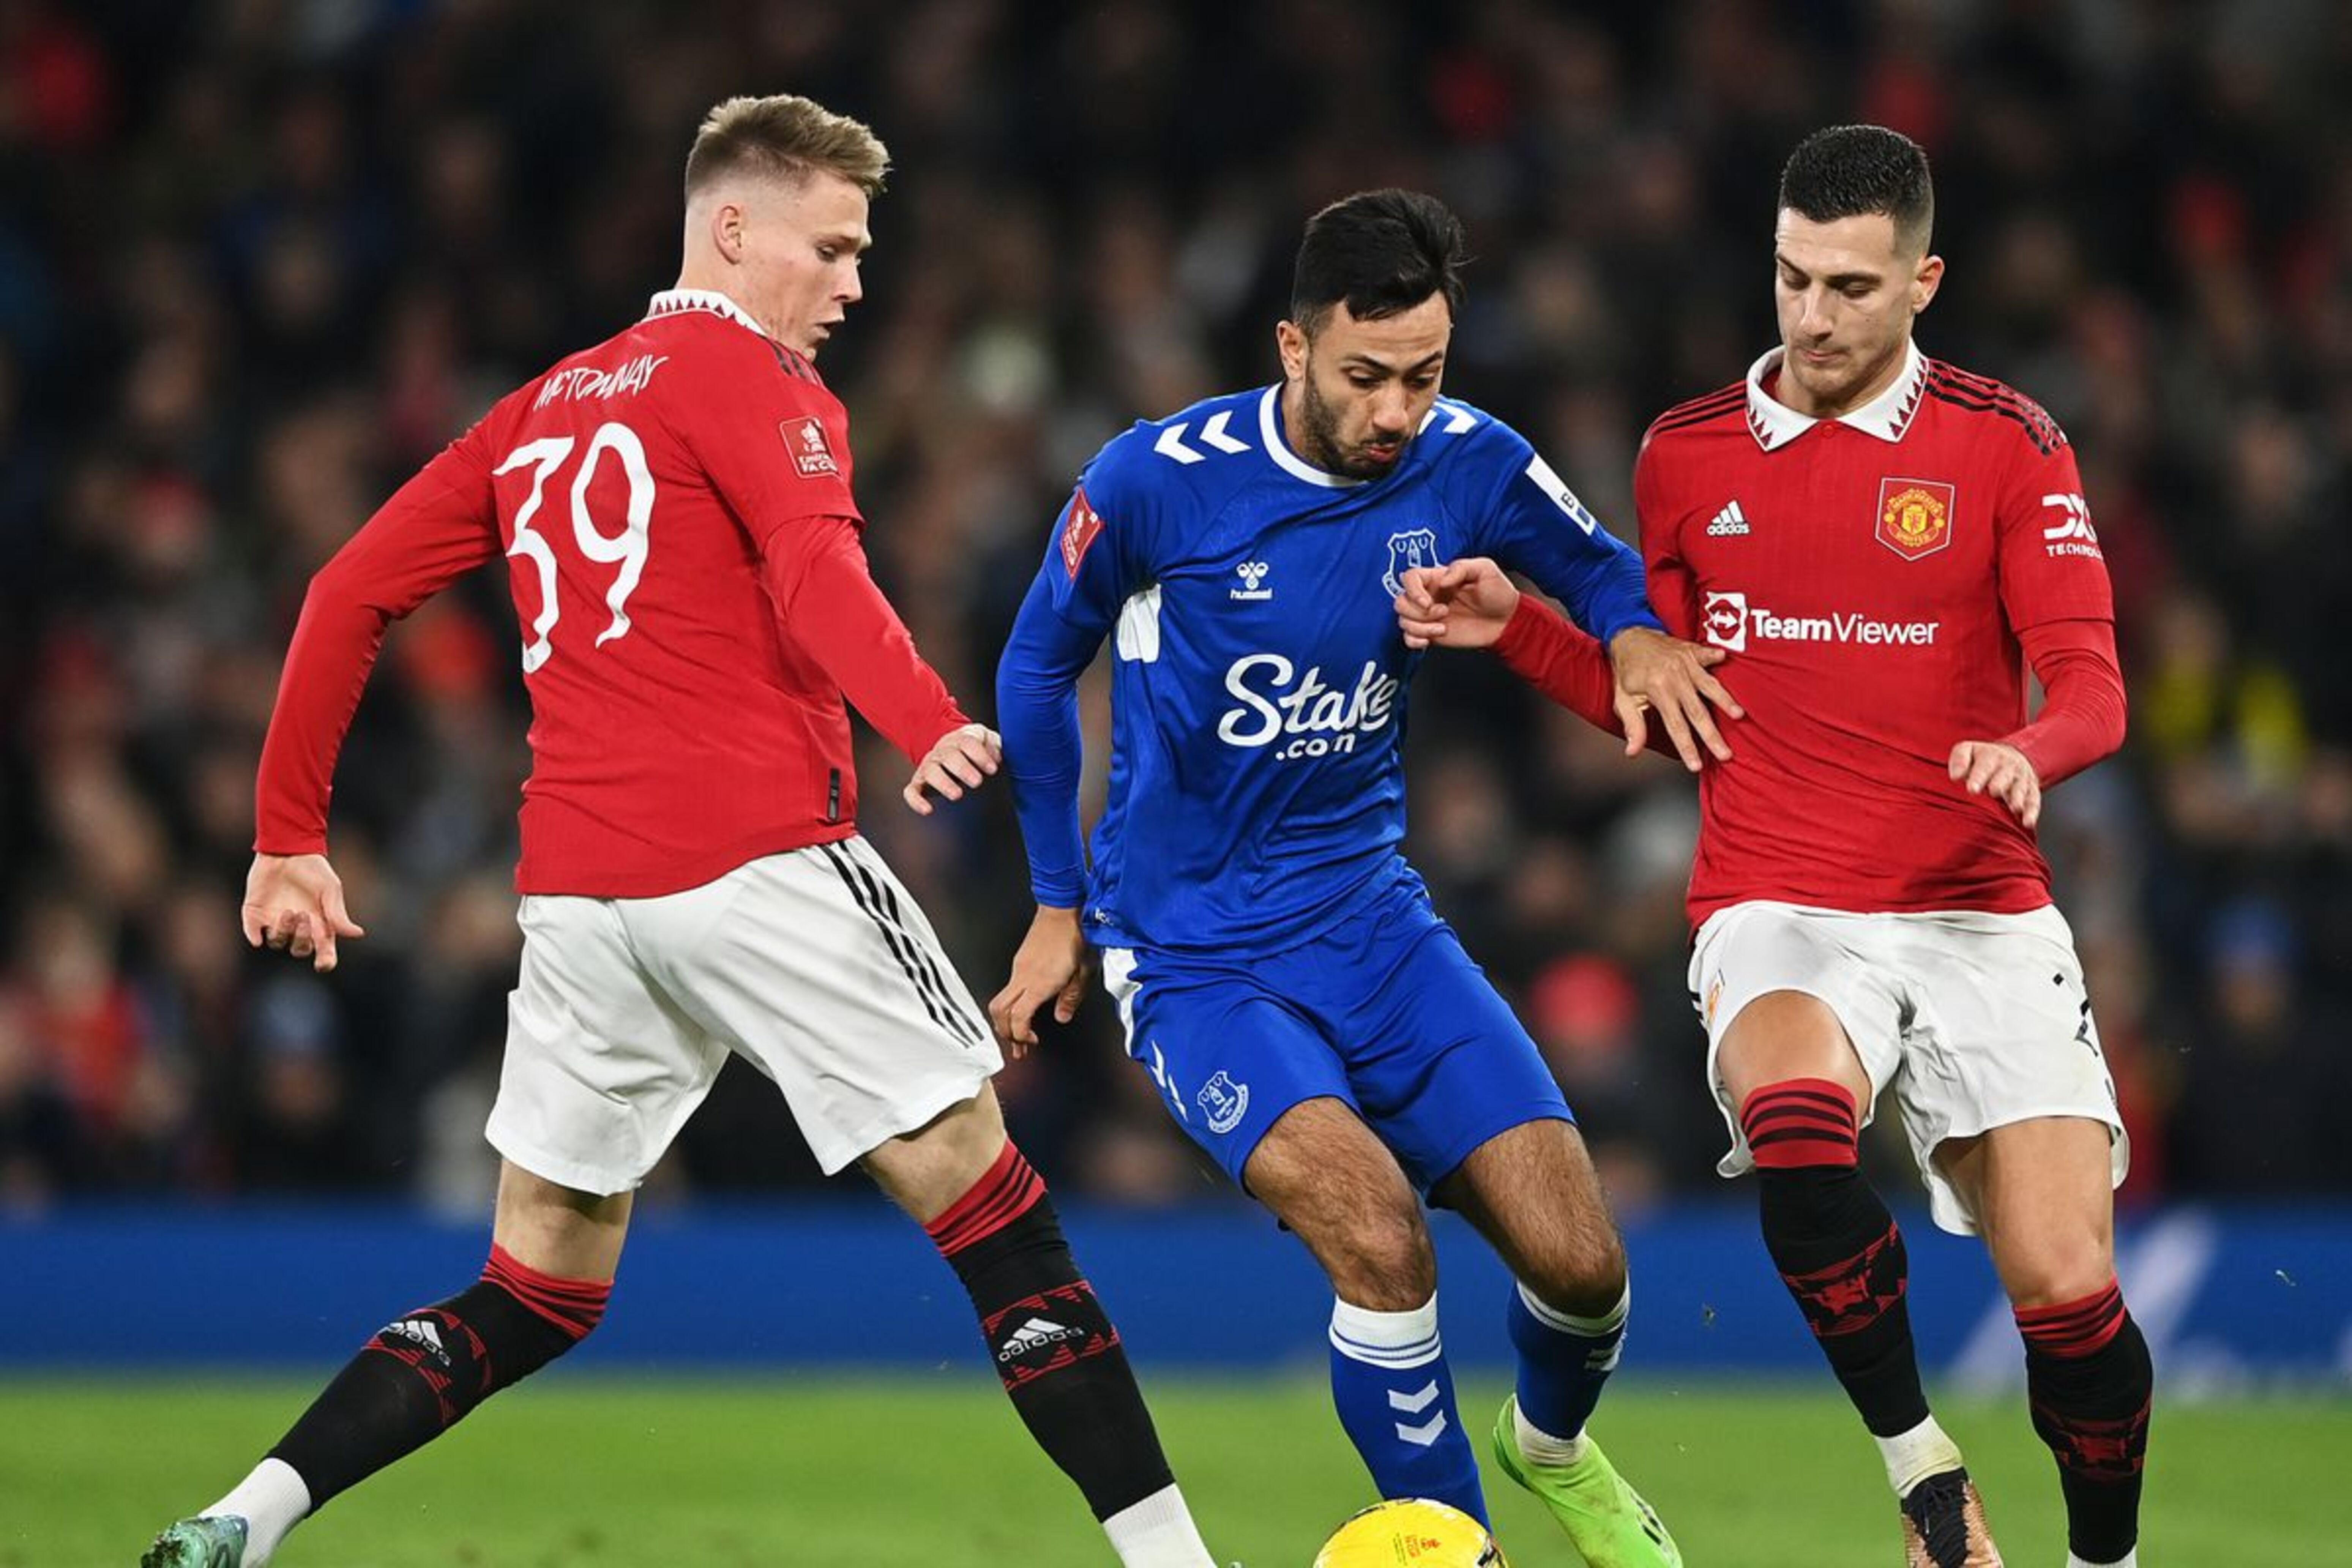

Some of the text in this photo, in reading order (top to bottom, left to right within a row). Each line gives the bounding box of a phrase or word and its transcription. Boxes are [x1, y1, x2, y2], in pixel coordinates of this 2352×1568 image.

[1707, 522, 1749, 536] adidas
[493, 422, 656, 674] 39
[1751, 608, 1939, 644] TeamViewer
[1217, 653, 1398, 747] Stake
[998, 1327, 1085, 1362] adidas
